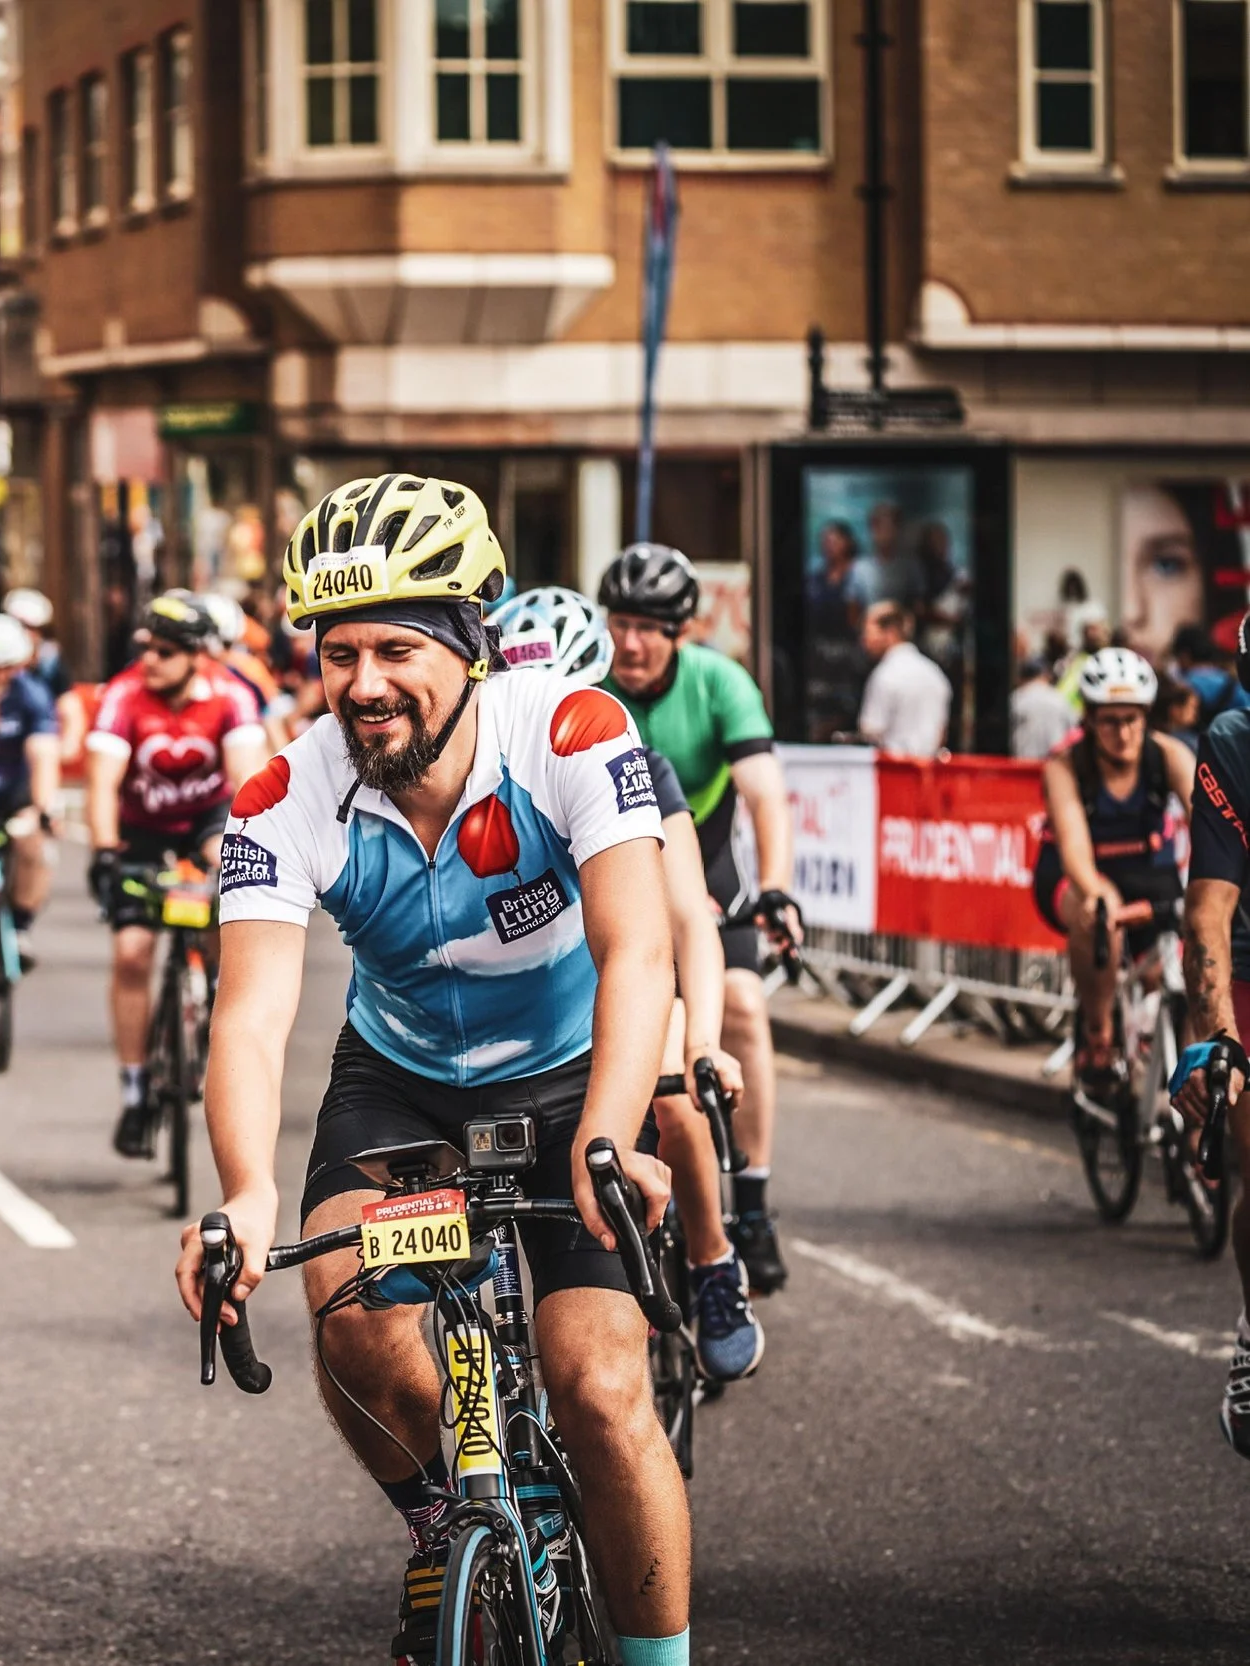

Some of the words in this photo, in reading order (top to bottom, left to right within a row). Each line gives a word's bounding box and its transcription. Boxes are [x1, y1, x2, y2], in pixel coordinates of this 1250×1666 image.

[313, 564, 373, 600] 24040
[620, 772, 653, 796] Lun
[222, 843, 267, 862] British
[498, 889, 560, 930] Lung
[501, 881, 553, 913] British
[506, 901, 563, 938] Foundation
[375, 1197, 435, 1217] PRUDENTIAL
[369, 1236, 380, 1259] B
[391, 1224, 462, 1256] 24040
